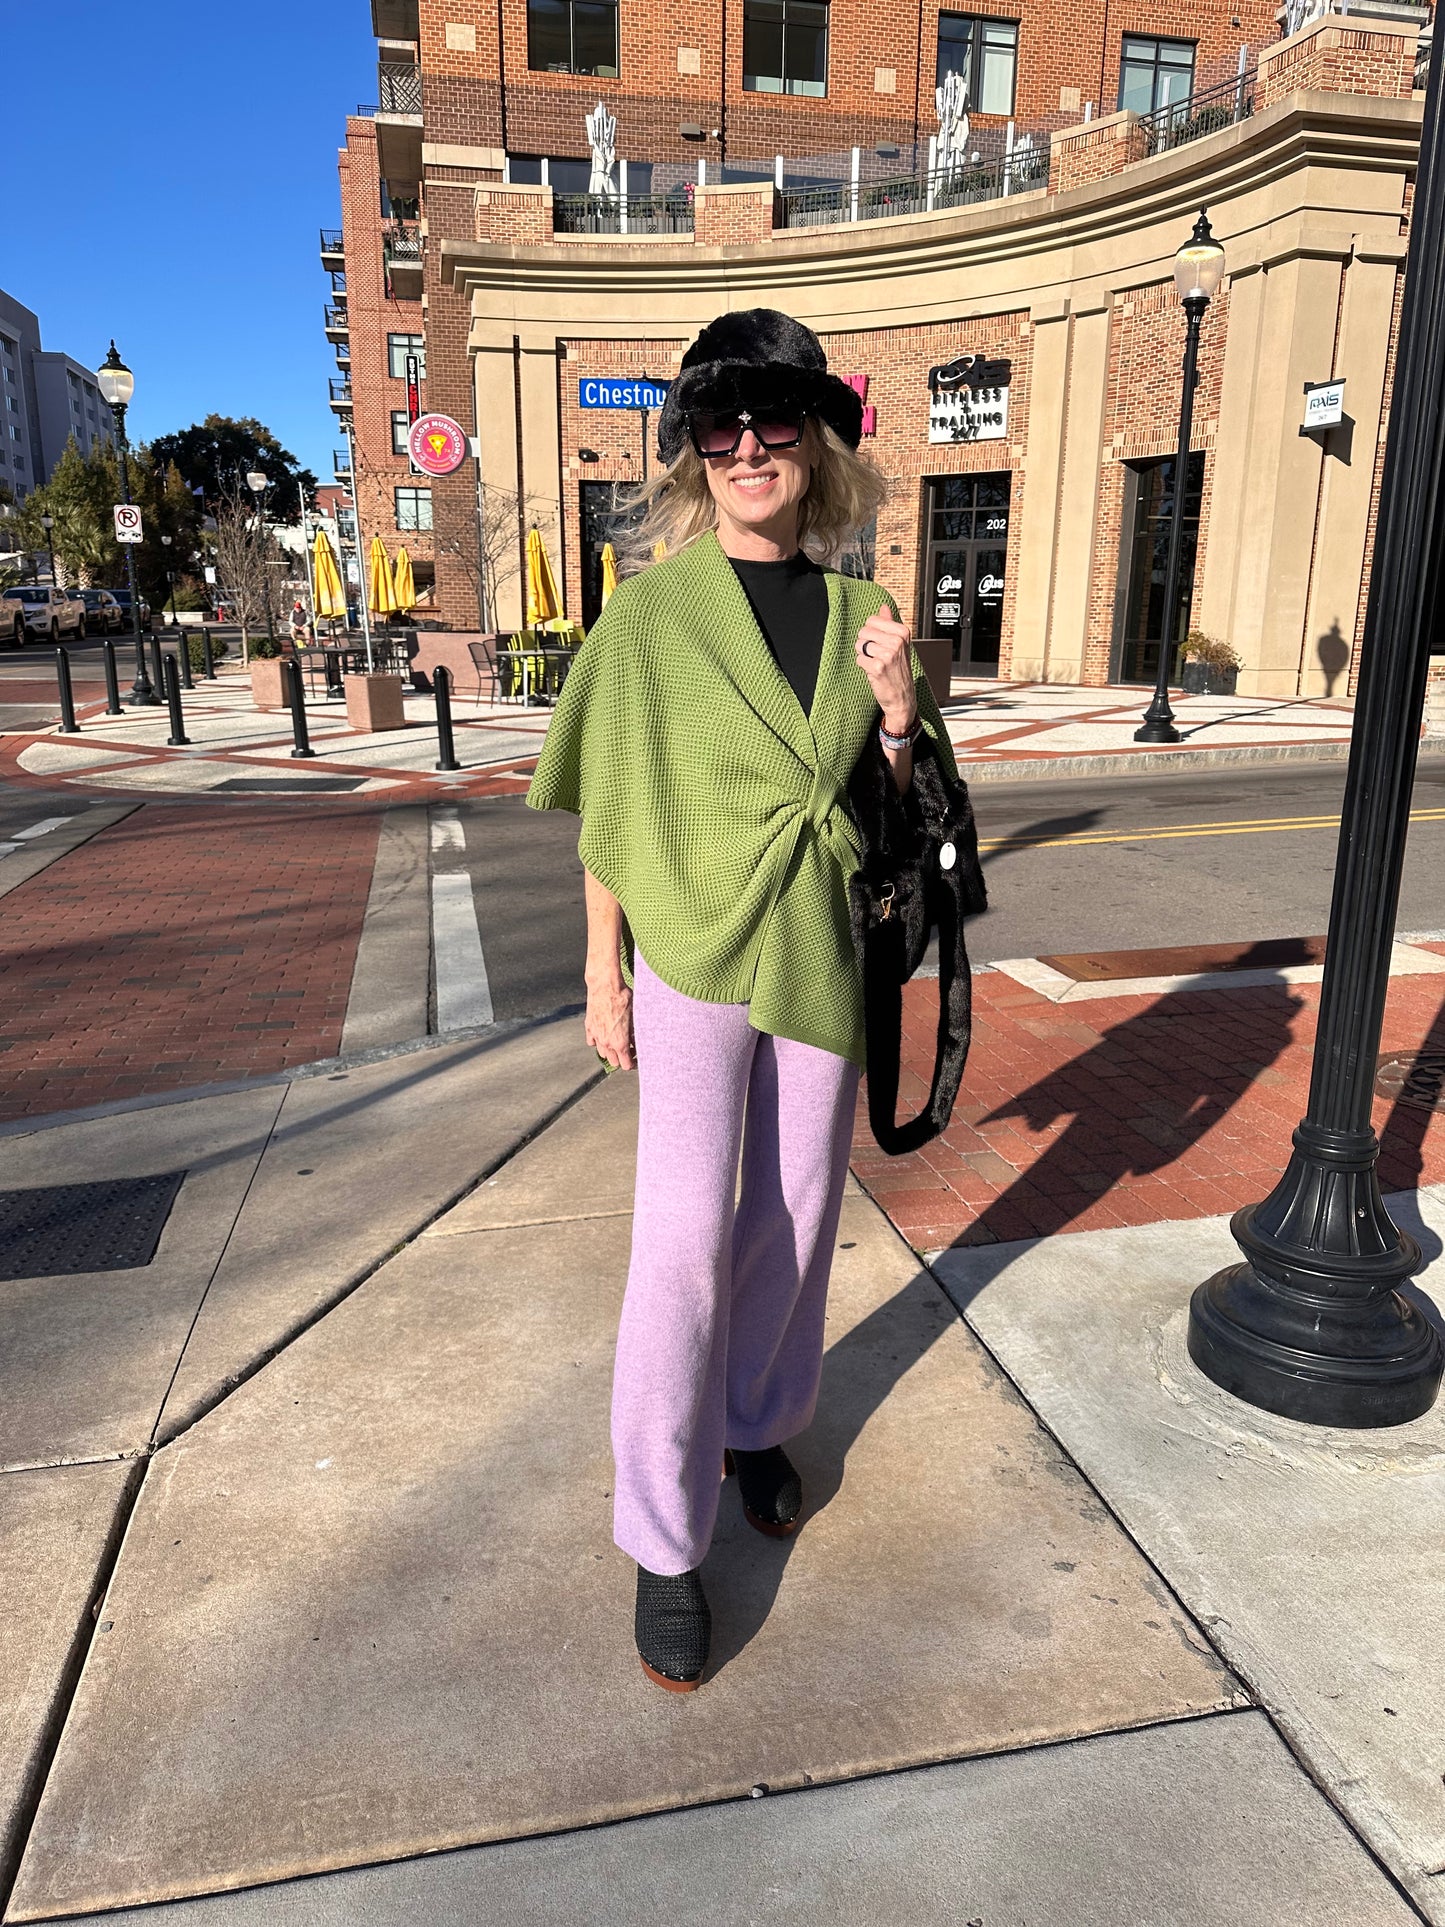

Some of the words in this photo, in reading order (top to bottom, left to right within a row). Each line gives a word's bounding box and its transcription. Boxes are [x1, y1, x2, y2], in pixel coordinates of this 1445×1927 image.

[585, 382, 667, 405] Chestnu
[409, 385, 418, 424] CHRI
[930, 412, 1003, 430] TRAINING
[986, 519, 1006, 530] 202
